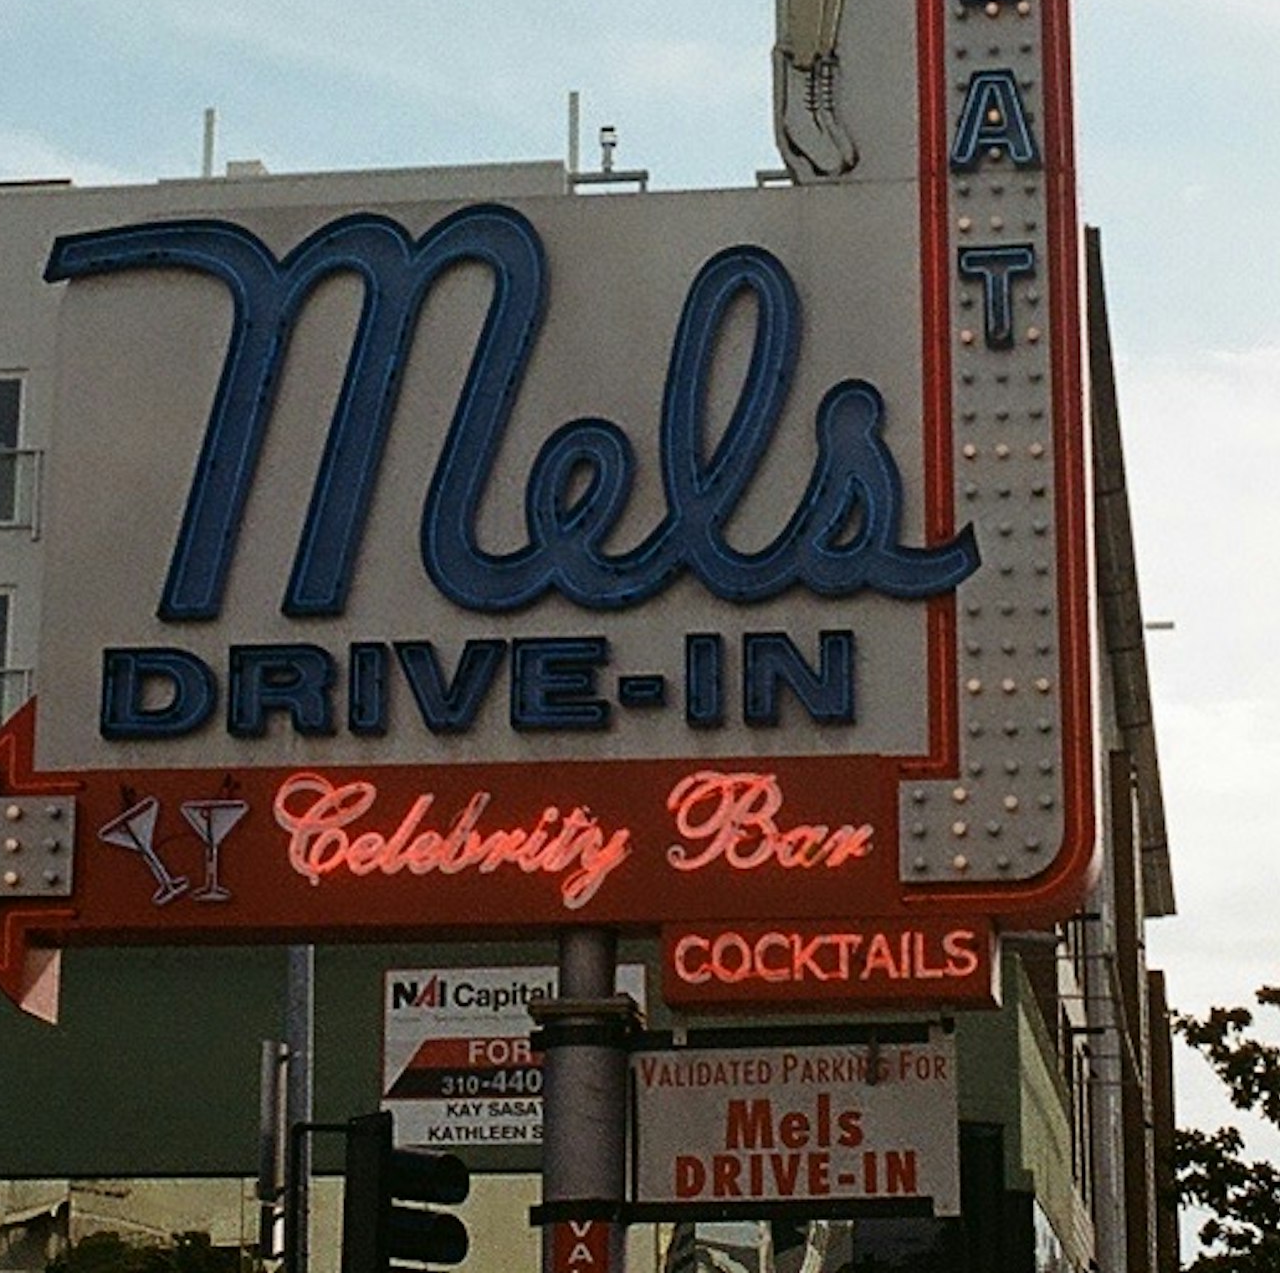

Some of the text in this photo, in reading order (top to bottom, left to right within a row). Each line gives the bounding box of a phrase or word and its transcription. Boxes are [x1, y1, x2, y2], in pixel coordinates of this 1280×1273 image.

[43, 201, 982, 622] Mels
[100, 629, 857, 742] DRIVE-IN
[271, 771, 873, 909] Celebrity Bar
[673, 928, 981, 984] COCKTAILS
[393, 976, 553, 1011] NAI Capital
[470, 1040, 531, 1063] FOR
[640, 1047, 947, 1088] VALIDATED PARKING FOR
[428, 1126, 526, 1142] KATHLEEN
[447, 1103, 485, 1117] KAY
[726, 1094, 866, 1150] Mels
[675, 1150, 917, 1198] DRIVE-IN
